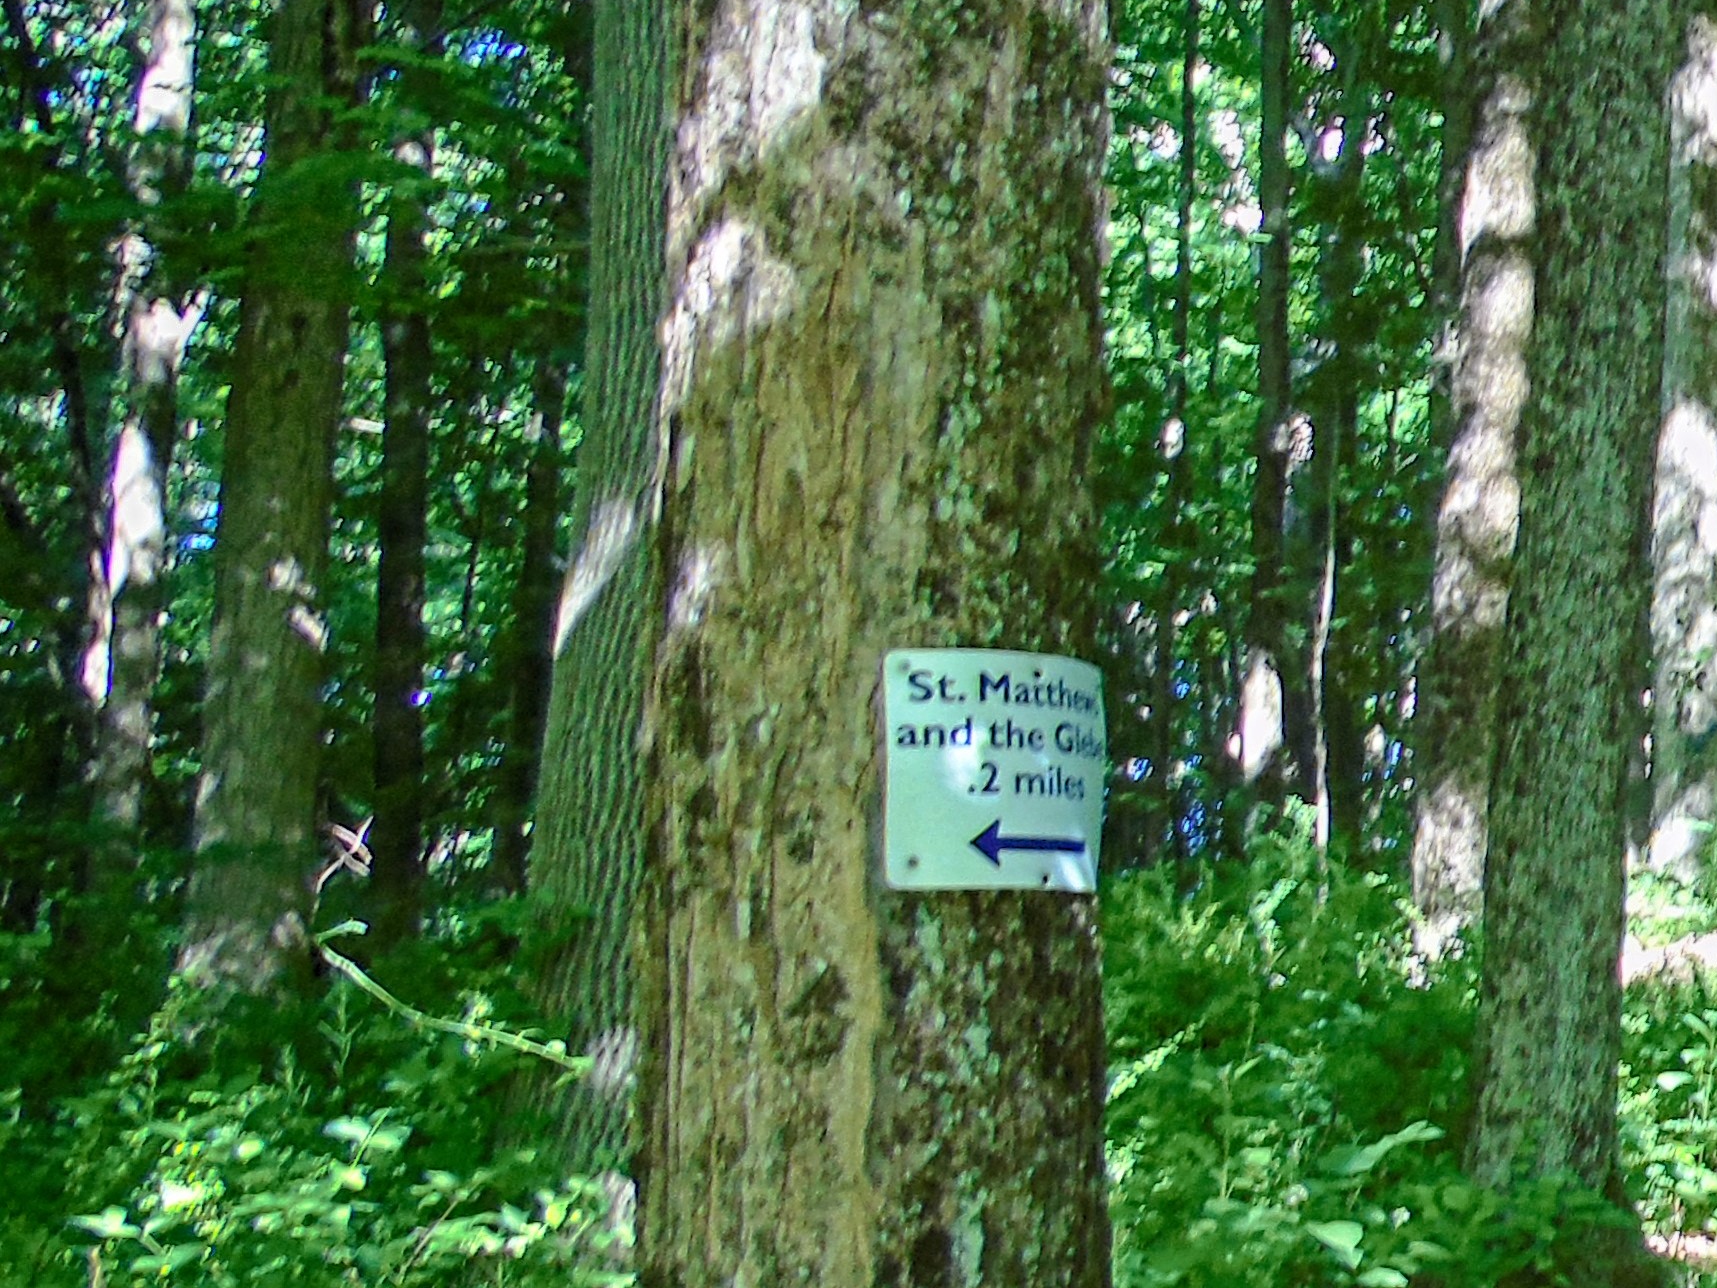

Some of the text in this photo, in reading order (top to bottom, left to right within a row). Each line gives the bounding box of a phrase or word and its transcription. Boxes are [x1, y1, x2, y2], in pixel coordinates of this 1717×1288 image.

[908, 670, 966, 703] St.
[897, 718, 973, 747] and
[990, 719, 1045, 752] the
[968, 762, 1084, 800] .2 miles
